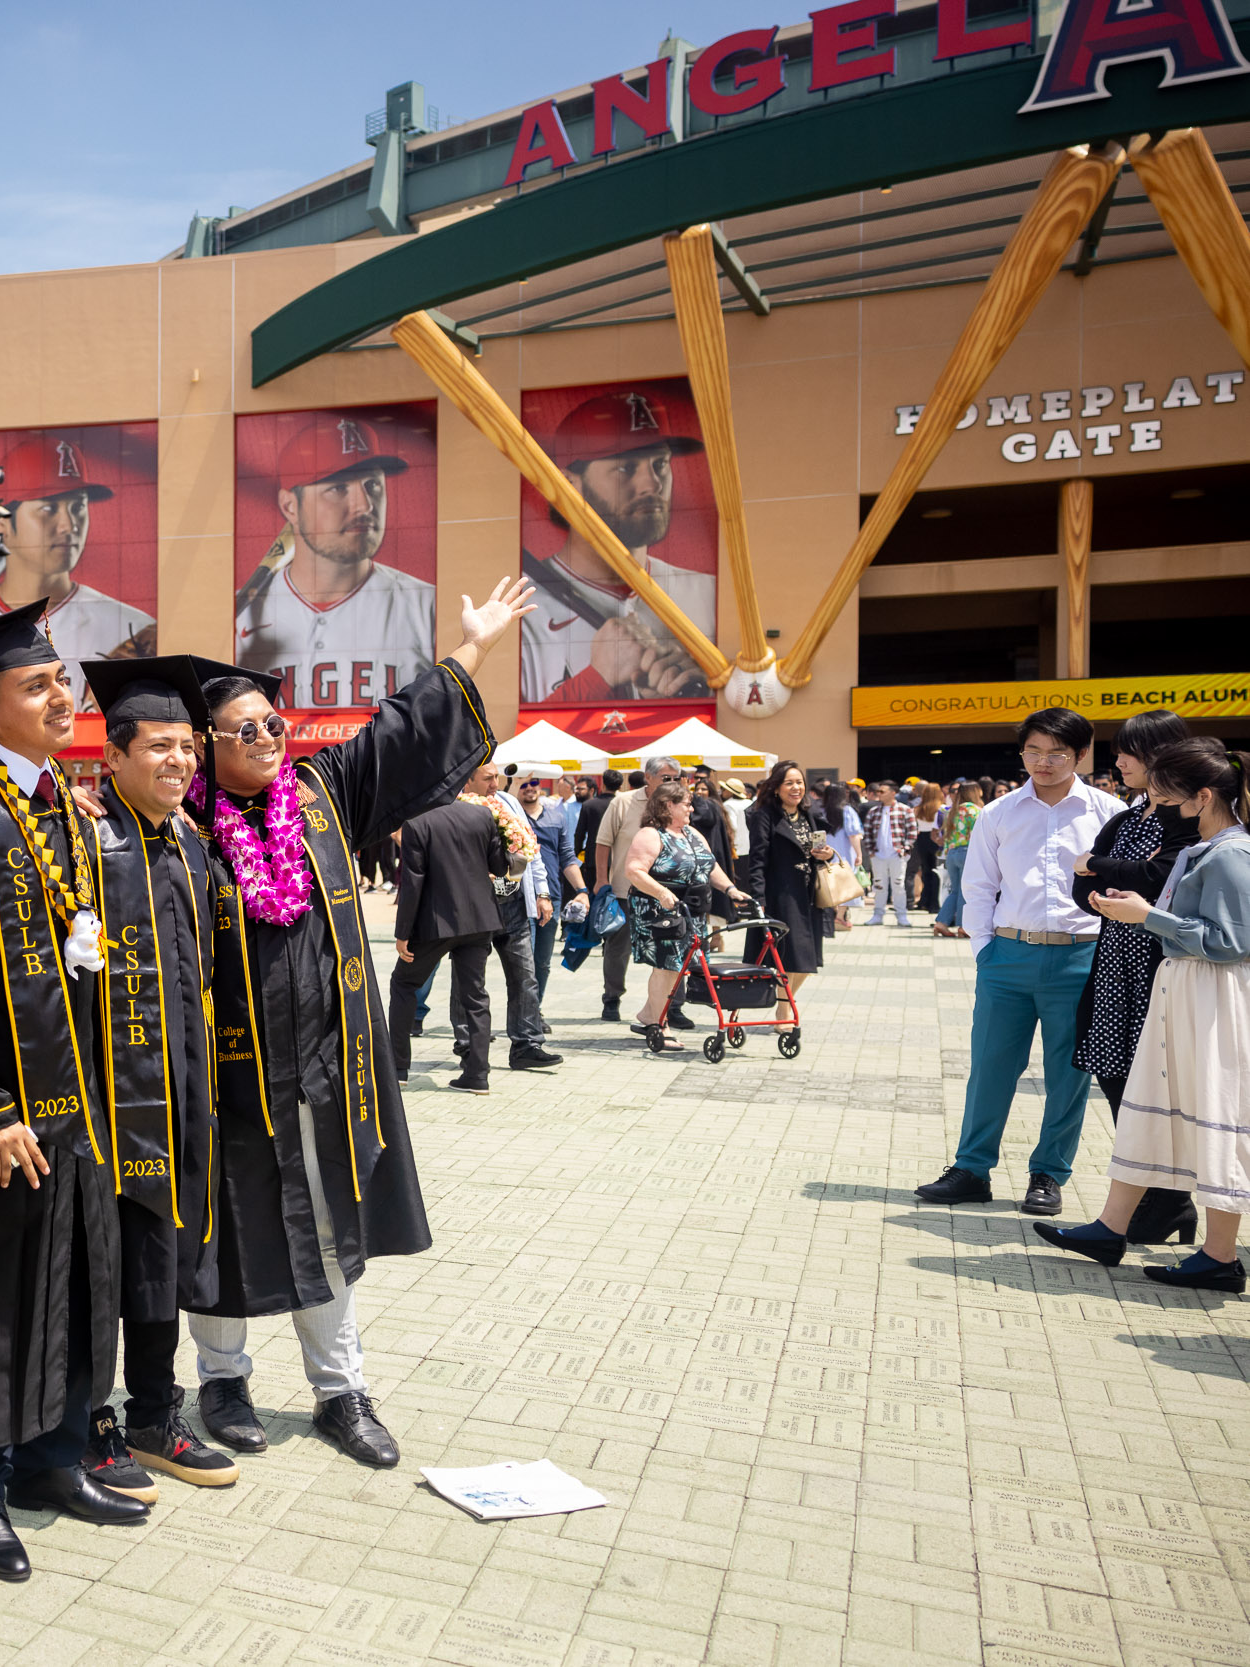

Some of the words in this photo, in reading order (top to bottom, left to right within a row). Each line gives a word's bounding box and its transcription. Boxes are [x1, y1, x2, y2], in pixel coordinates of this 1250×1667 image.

[503, 0, 1033, 187] ANGEL
[1001, 420, 1163, 463] GATE
[889, 693, 1095, 714] CONGRATULATIONS
[1100, 690, 1177, 707] BEACH
[217, 1026, 245, 1038] College
[228, 1038, 237, 1049] of
[217, 1051, 254, 1062] Business
[356, 1033, 368, 1122] CSULB
[34, 1094, 80, 1118] 2023
[123, 1158, 166, 1178] 2023
[159, 1529, 188, 1539] DAVID
[333, 1604, 357, 1629] MATTHEW
[345, 1599, 374, 1632] HERNANDEZ
[404, 1611, 430, 1642] HERNANDEZ
[456, 1614, 512, 1633] BARBARA
[194, 1620, 227, 1652] HERNANDEZ
